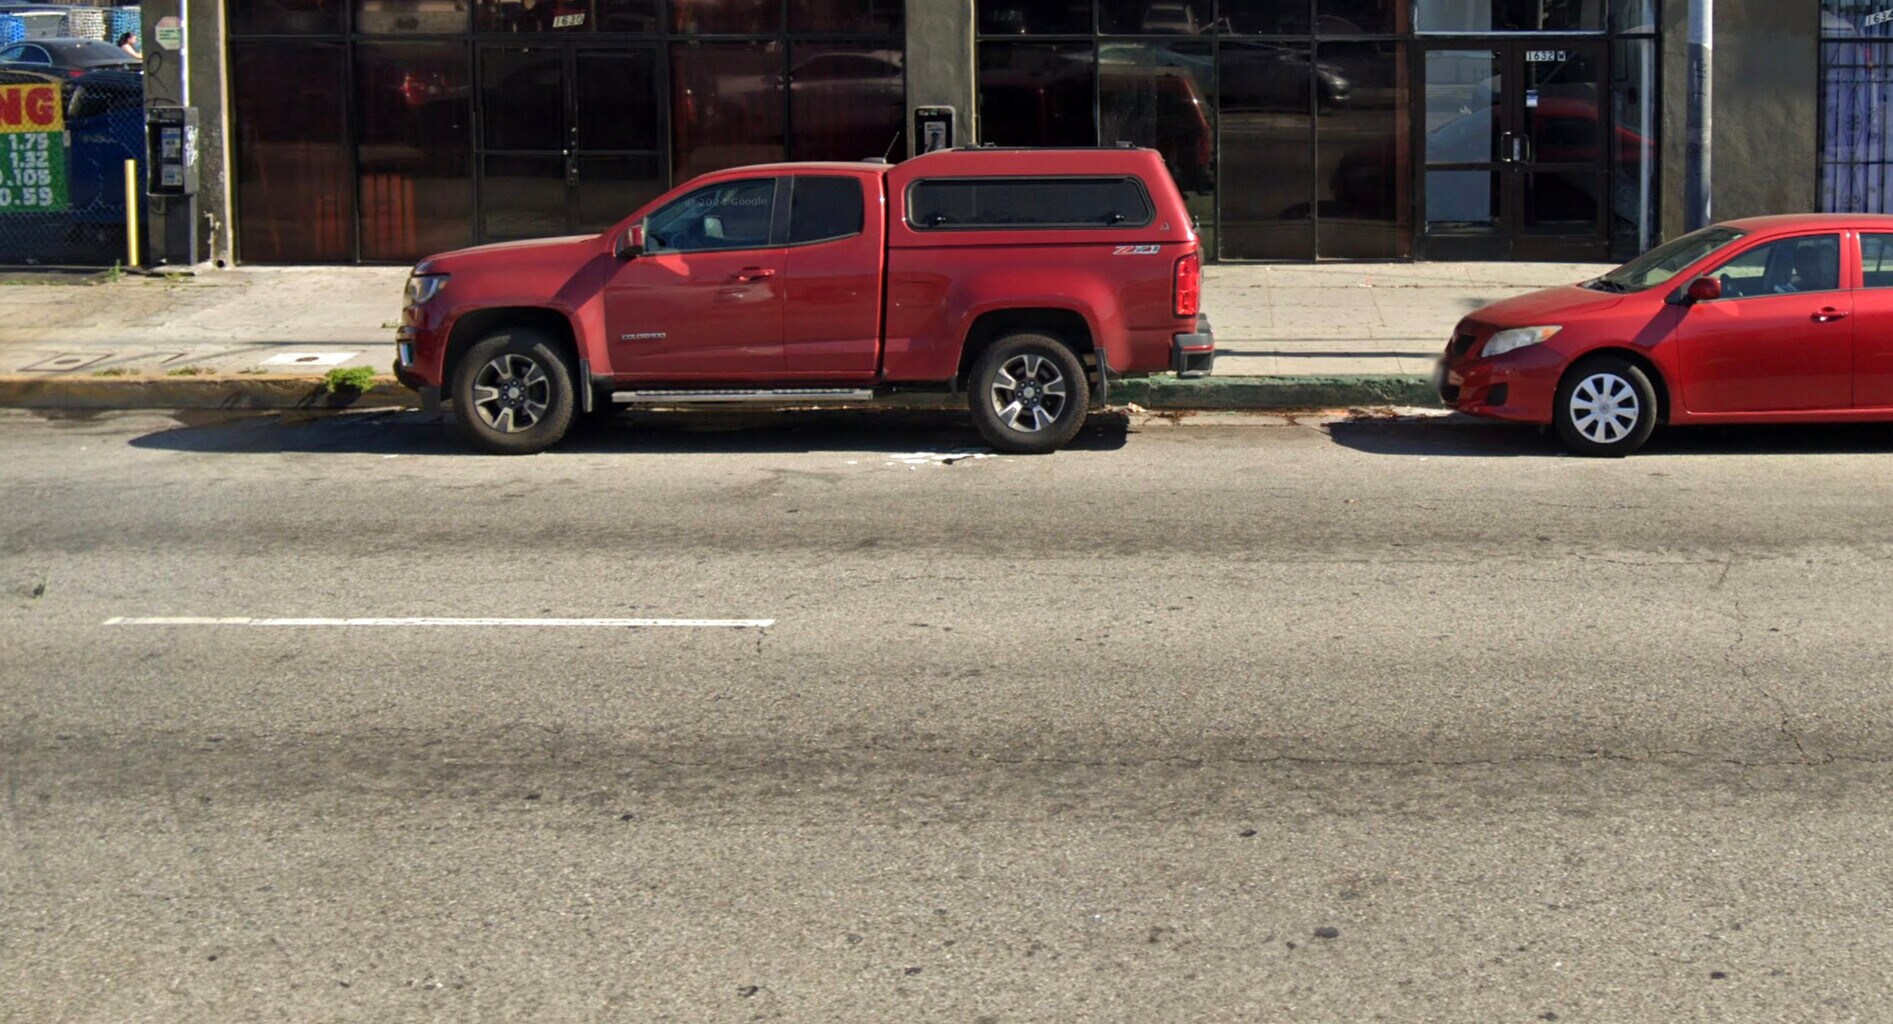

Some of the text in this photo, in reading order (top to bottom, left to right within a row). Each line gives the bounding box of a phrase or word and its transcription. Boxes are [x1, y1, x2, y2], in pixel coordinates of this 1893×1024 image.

[555, 15, 583, 26] 1630
[1527, 51, 1554, 61] 1632
[8, 133, 49, 150] 1.75
[0, 169, 52, 186] .105
[1112, 245, 1161, 255] Z71
